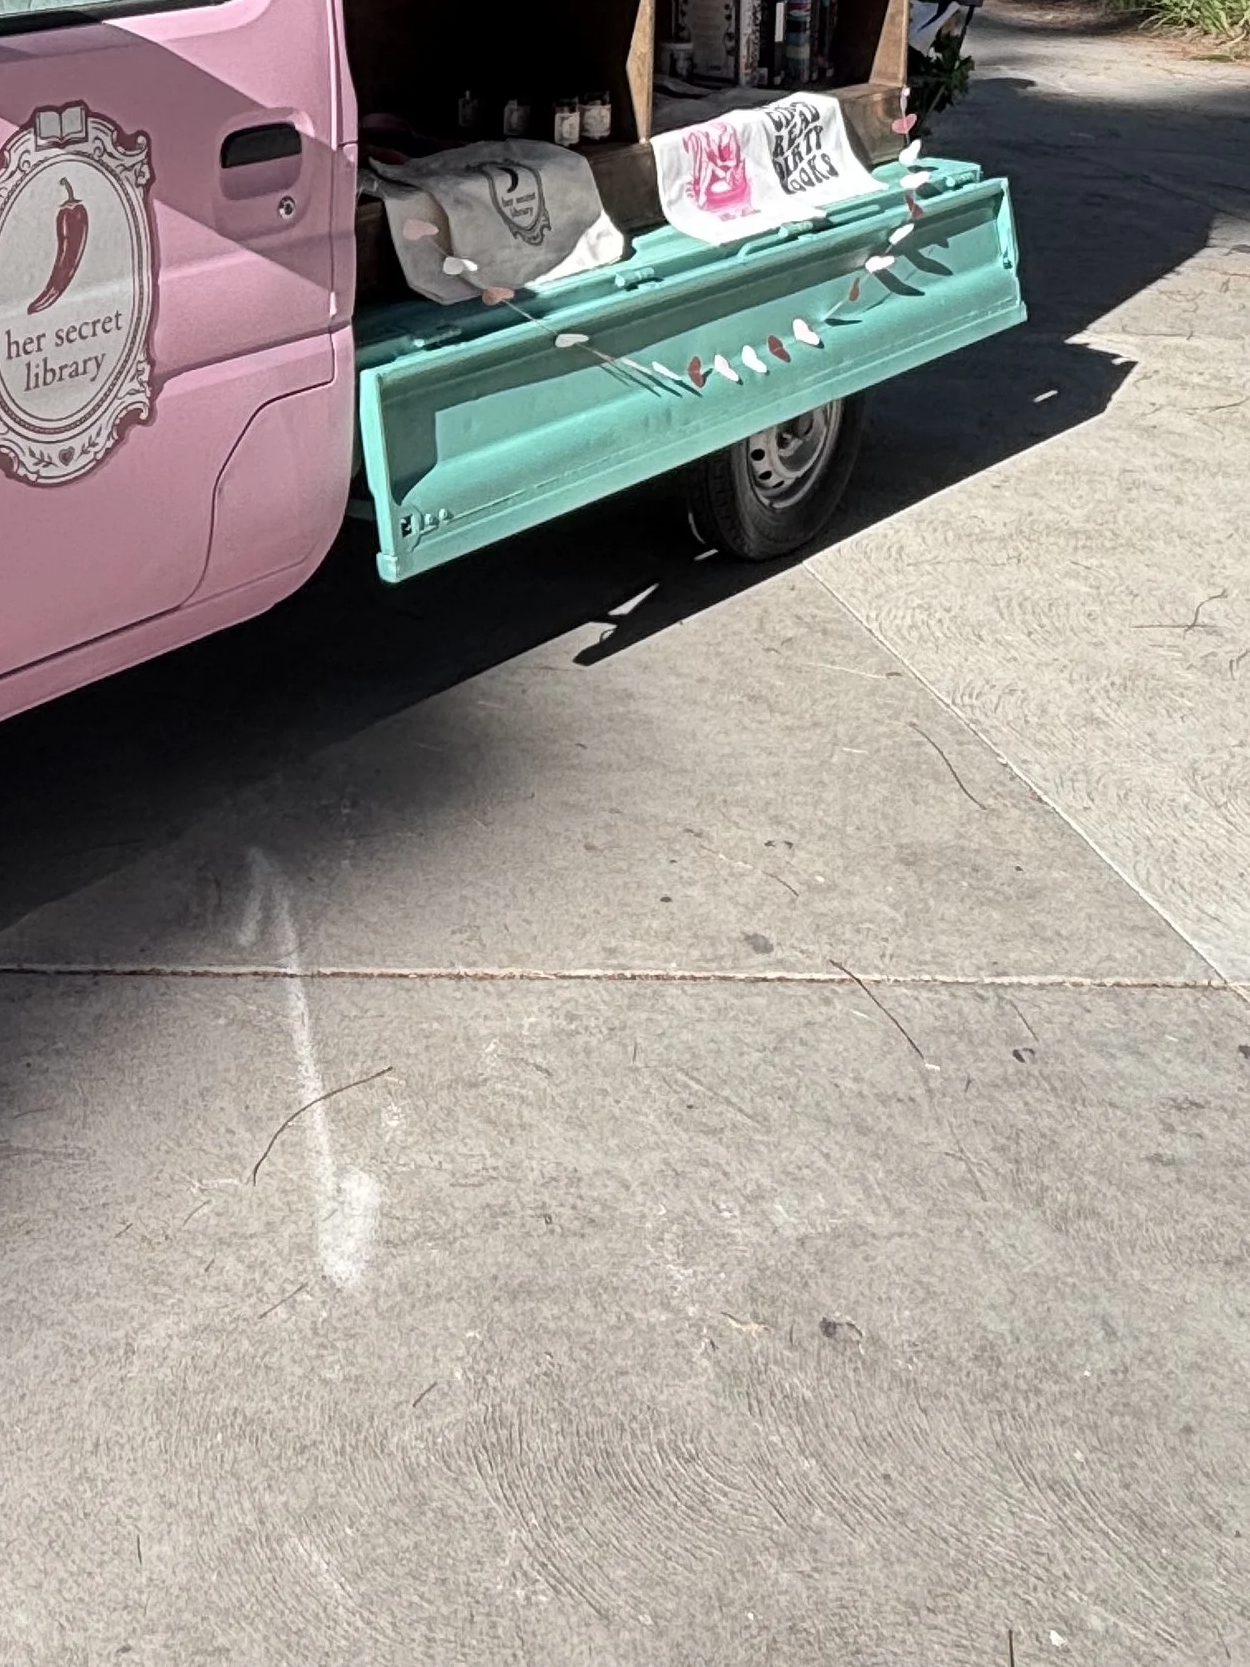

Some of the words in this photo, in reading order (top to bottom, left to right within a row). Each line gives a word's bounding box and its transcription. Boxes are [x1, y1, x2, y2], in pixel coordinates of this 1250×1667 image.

[5, 329, 46, 360] her
[54, 310, 122, 346] secret
[23, 352, 106, 392] library
